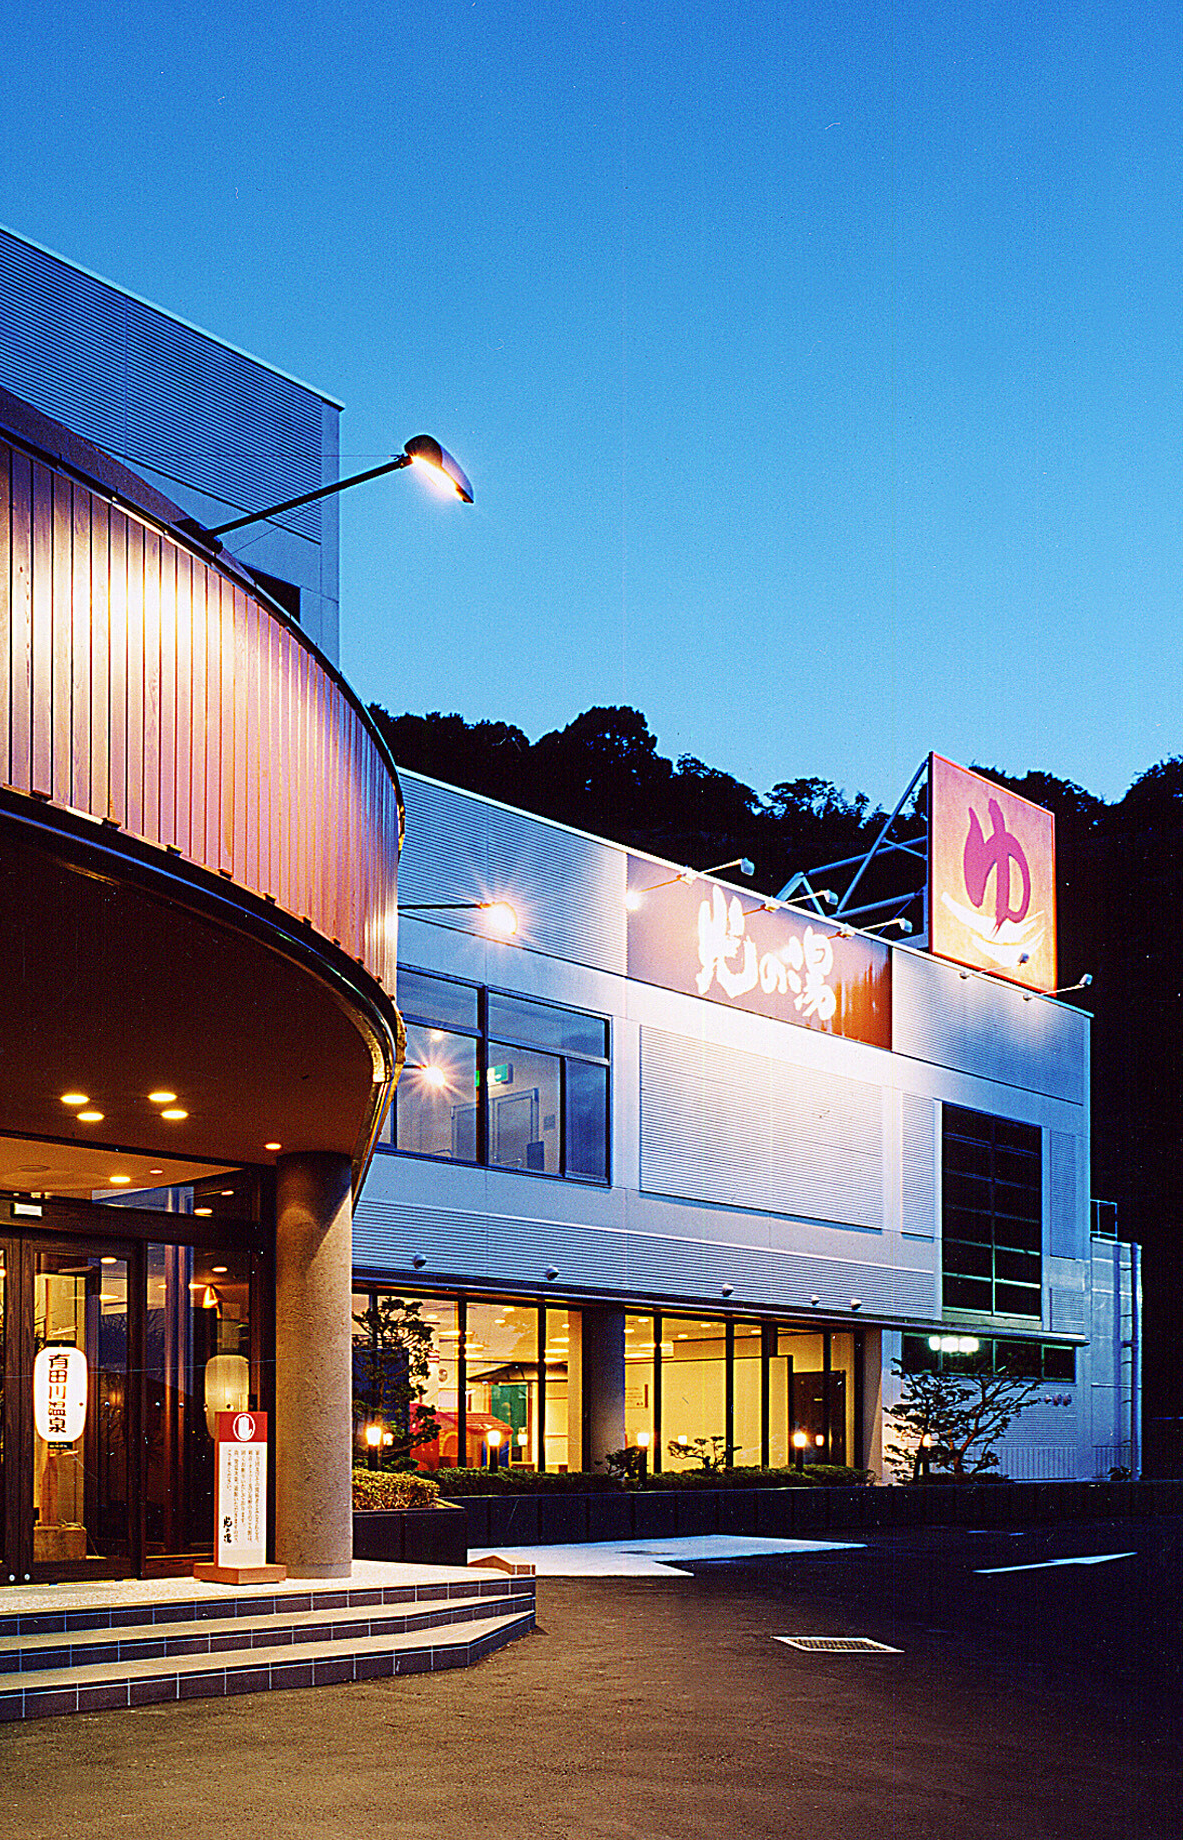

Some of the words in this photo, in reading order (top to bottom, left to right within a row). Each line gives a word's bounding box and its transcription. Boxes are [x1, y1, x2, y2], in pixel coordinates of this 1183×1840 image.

[963, 798, 1031, 937] ゆ
[48, 1354, 70, 1433] 有田川温泉
